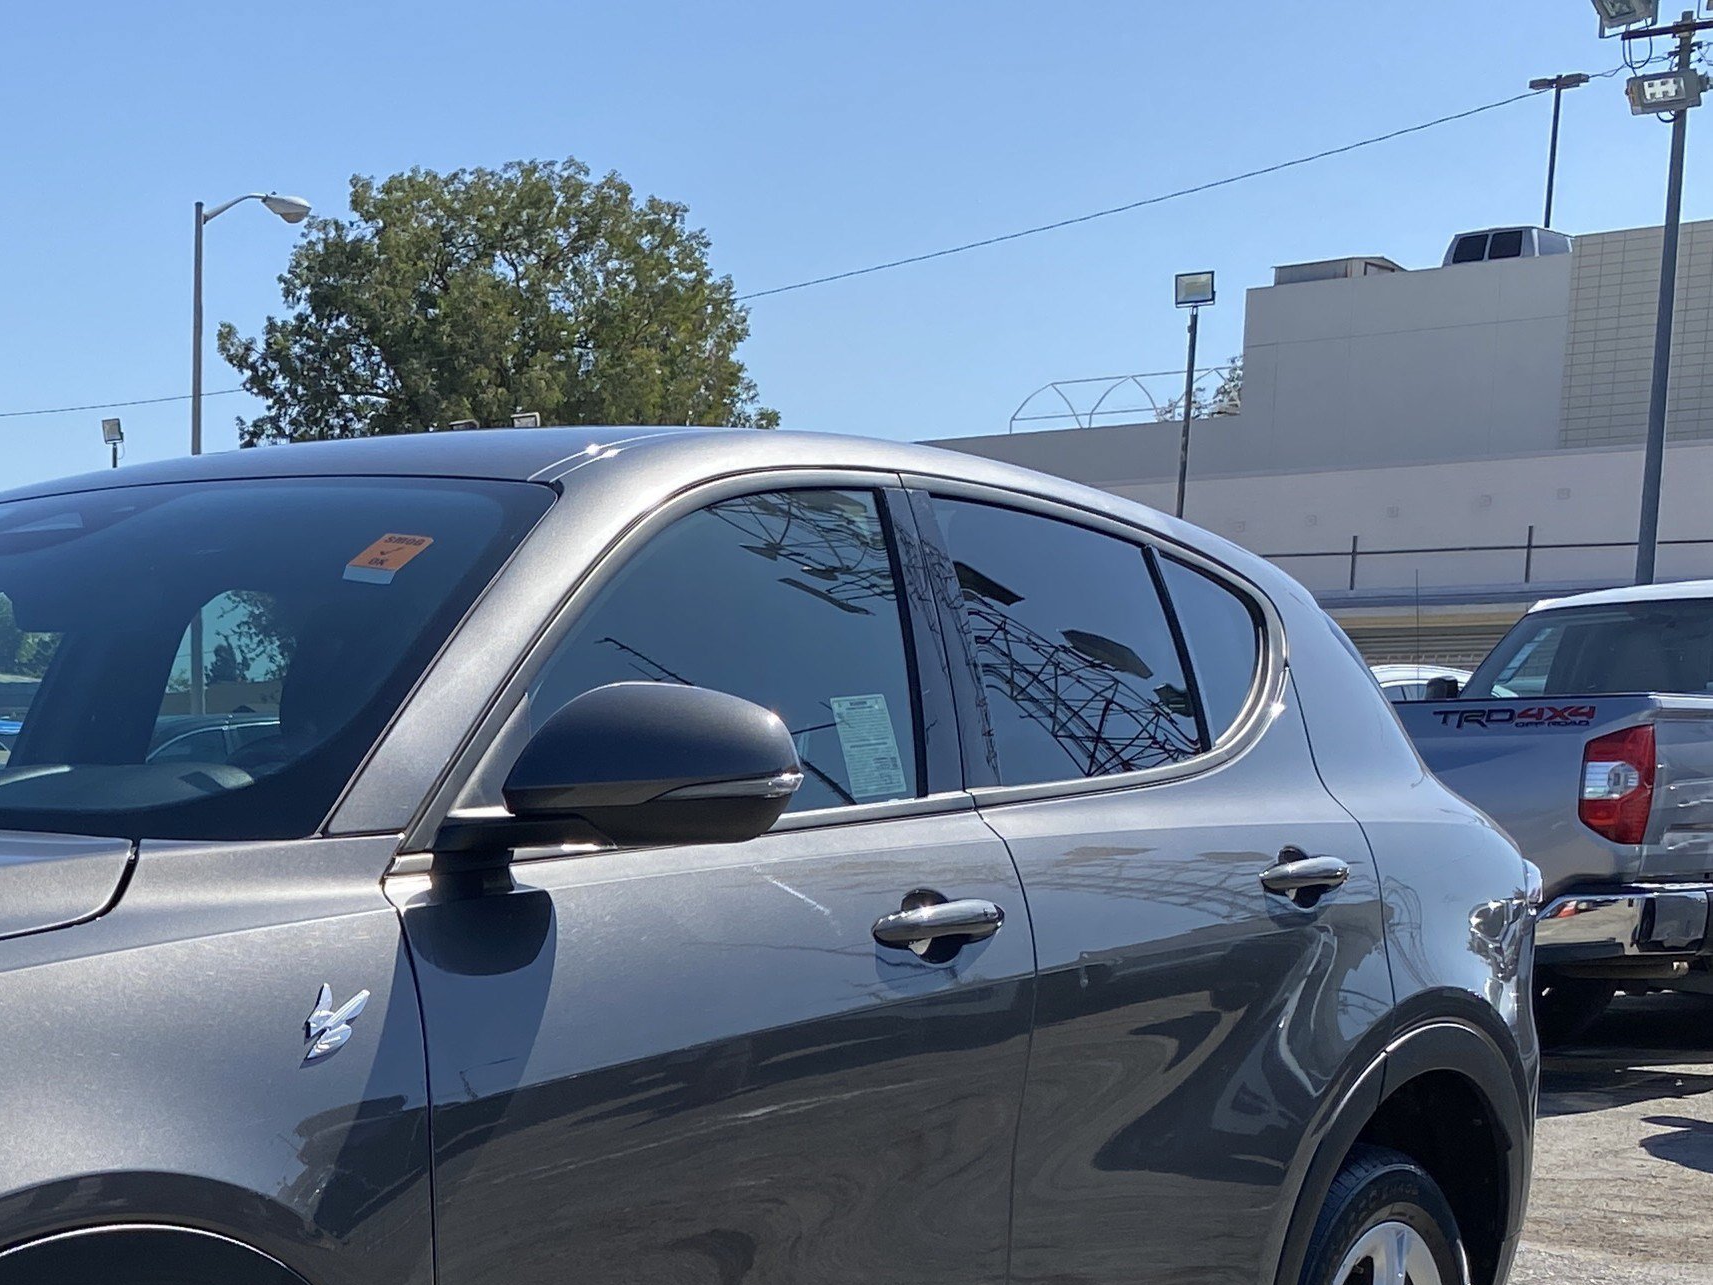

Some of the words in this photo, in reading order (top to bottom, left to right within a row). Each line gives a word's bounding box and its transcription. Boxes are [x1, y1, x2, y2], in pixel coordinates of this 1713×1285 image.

[385, 536, 426, 546] SMOG
[367, 556, 388, 566] OK
[1515, 720, 1545, 728] OFF
[1547, 719, 1591, 728] ROAD
